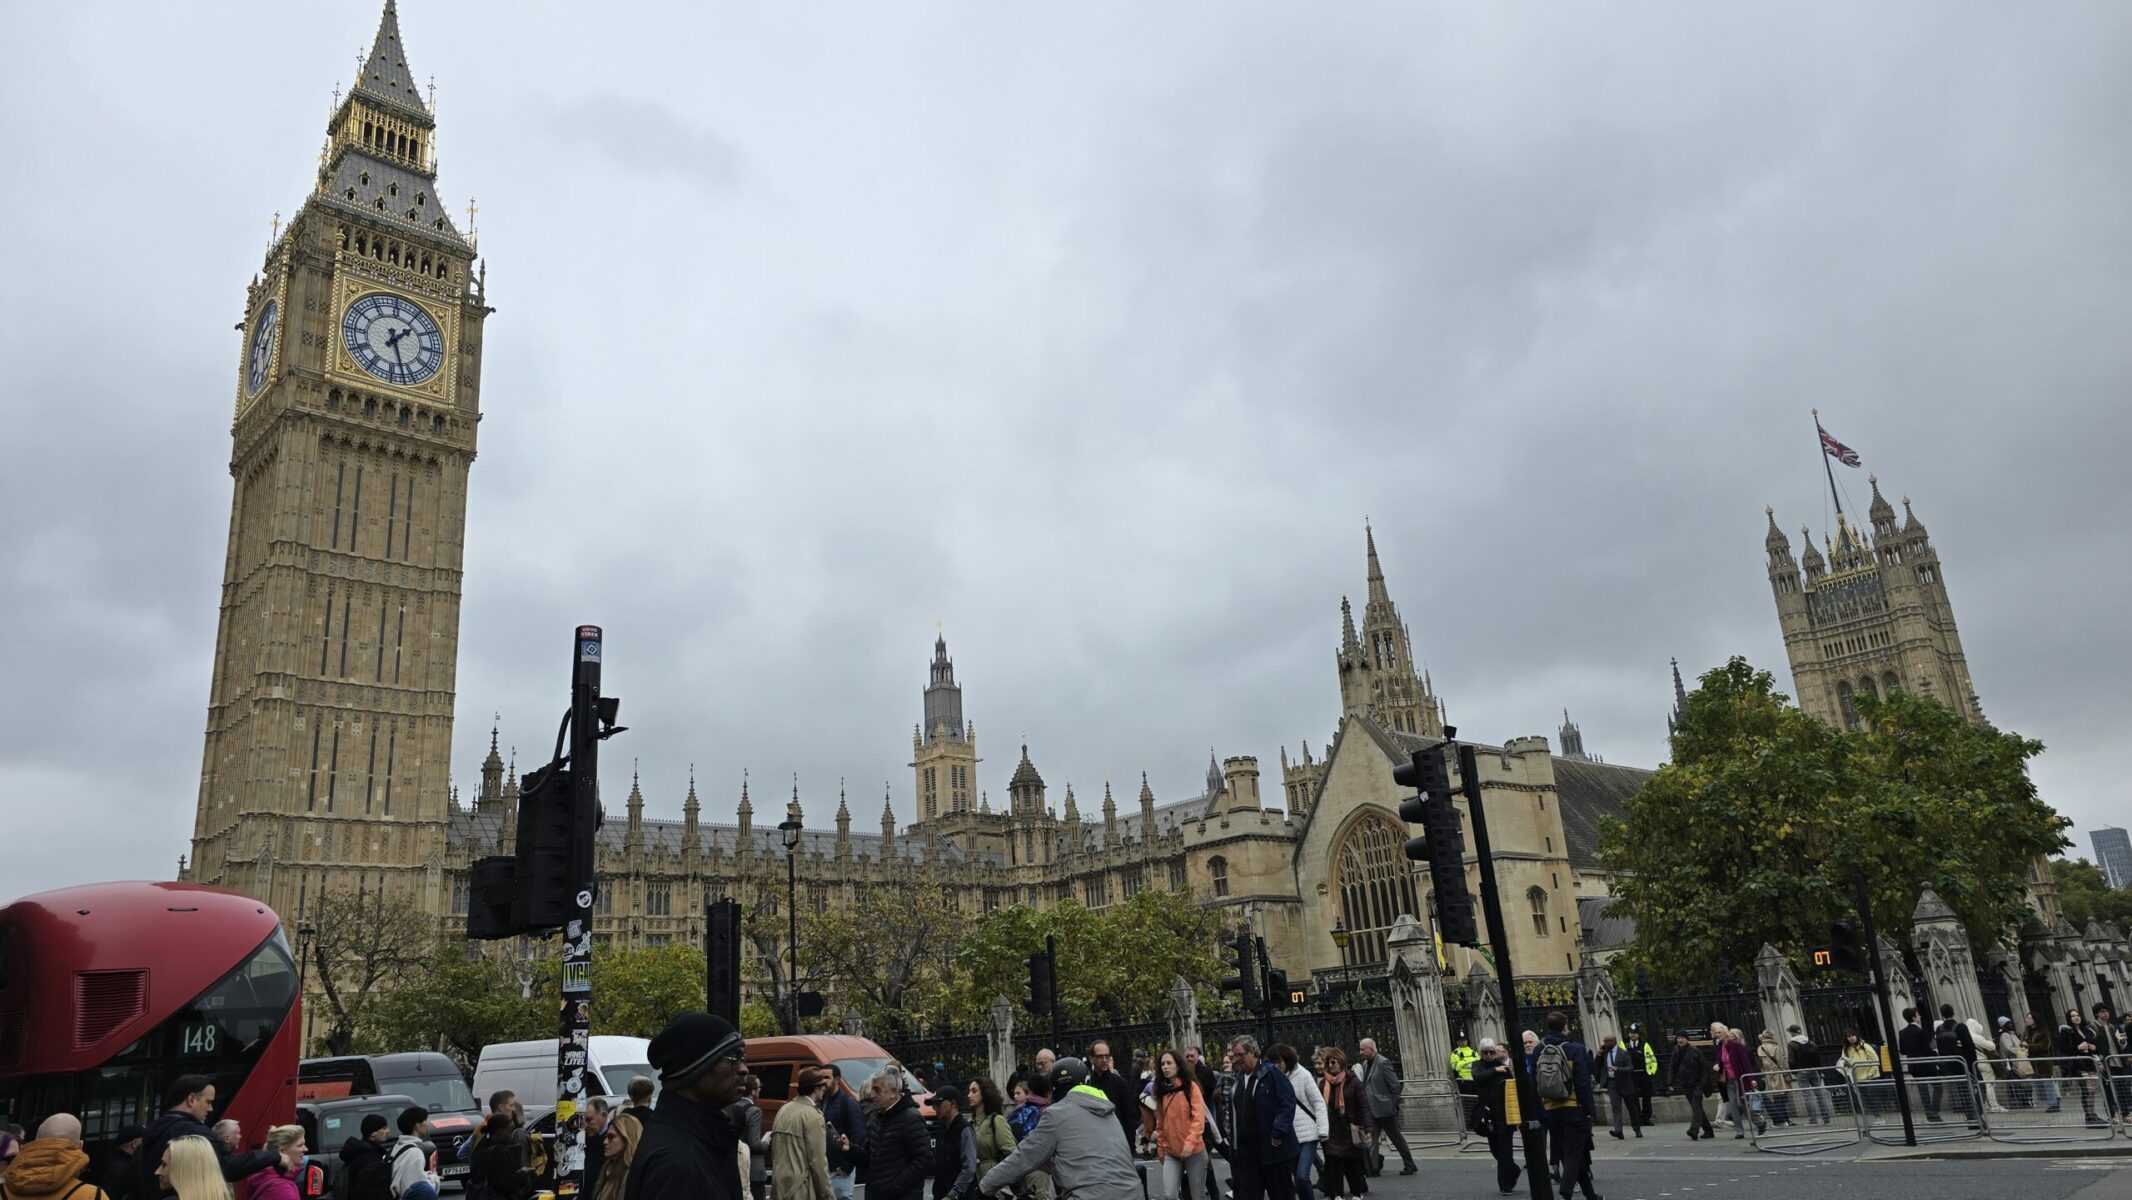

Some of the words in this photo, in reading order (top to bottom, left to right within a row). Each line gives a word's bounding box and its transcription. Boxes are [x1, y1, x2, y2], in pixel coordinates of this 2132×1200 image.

[1815, 951, 1831, 965] 07
[1291, 991, 1304, 1003] 07
[183, 1024, 216, 1054] 148
